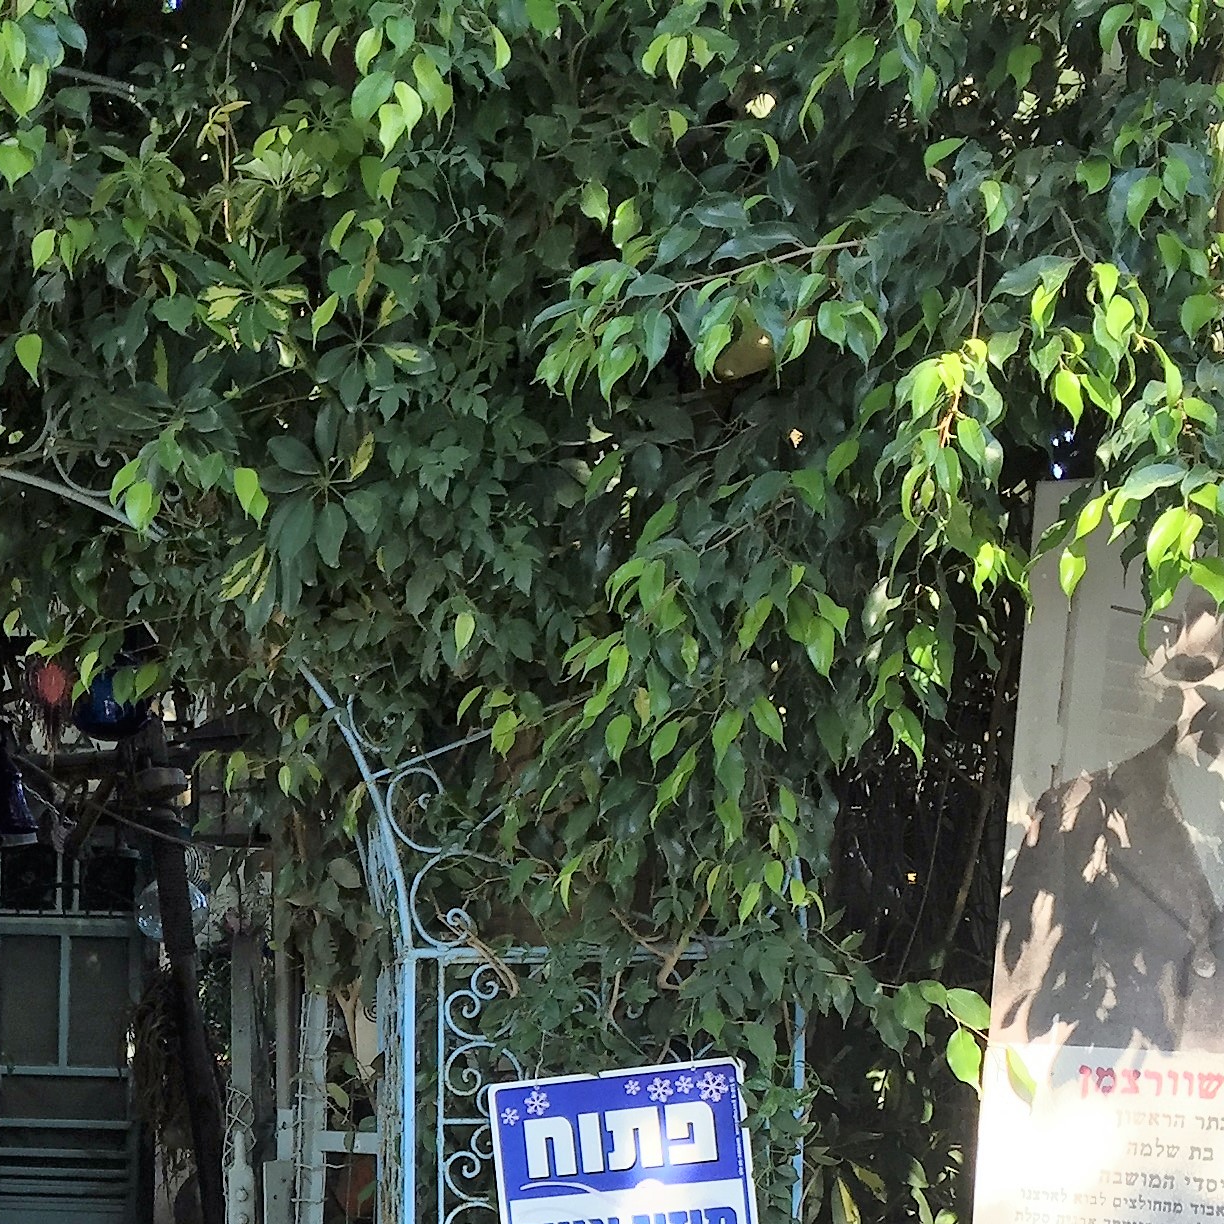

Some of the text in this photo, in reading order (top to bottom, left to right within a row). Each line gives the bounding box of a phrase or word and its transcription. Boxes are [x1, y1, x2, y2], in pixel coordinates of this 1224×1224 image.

[1079, 1064, 1224, 1099] שוורצמן
[1115, 1109, 1185, 1129] הראשון
[523, 1101, 718, 1178] פתוח
[1128, 1138, 1214, 1161] בת שלמה
[1099, 1168, 1175, 1189] המושבה
[1113, 1194, 1183, 1213] מהחולצים
